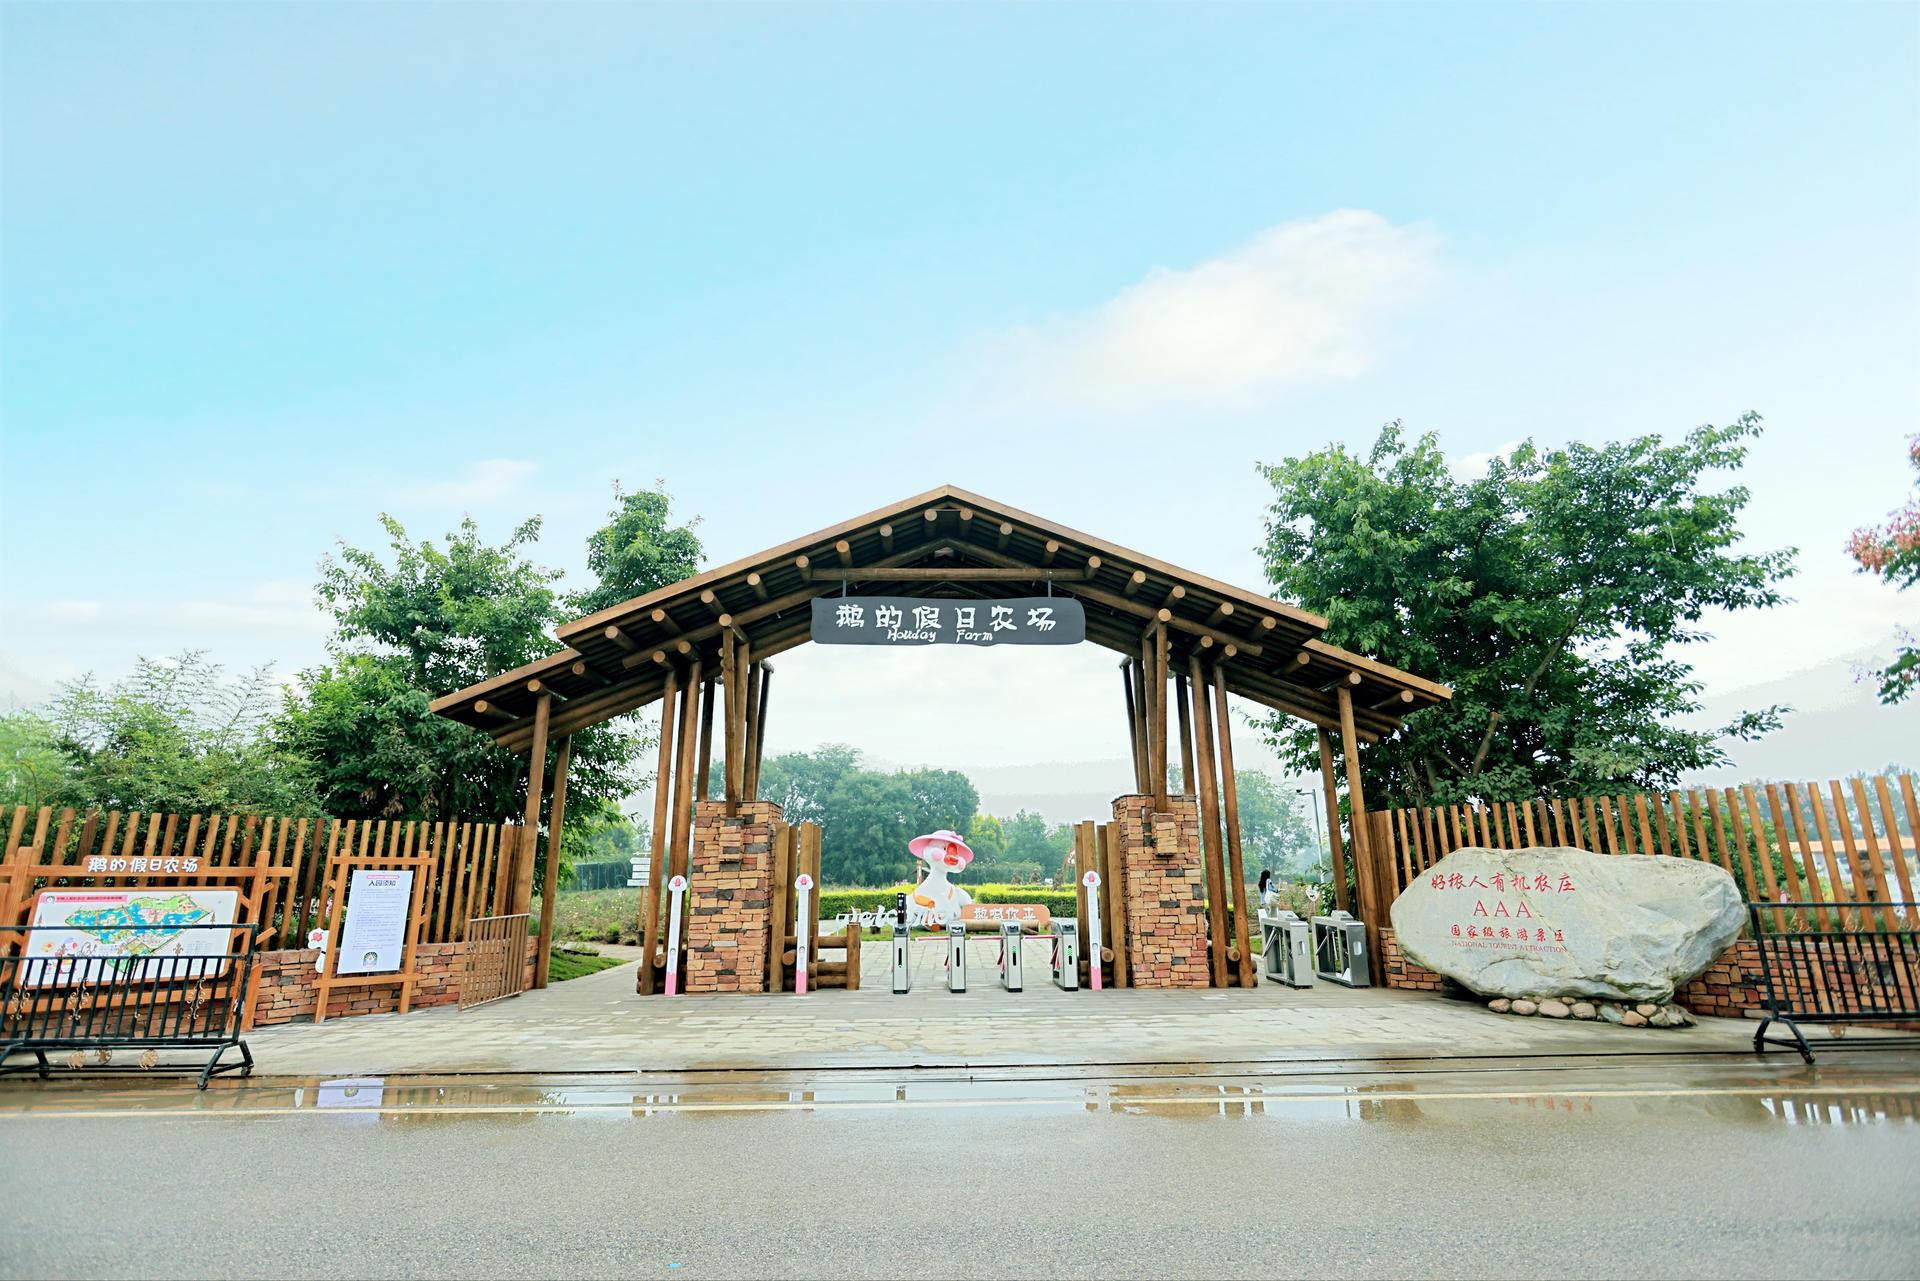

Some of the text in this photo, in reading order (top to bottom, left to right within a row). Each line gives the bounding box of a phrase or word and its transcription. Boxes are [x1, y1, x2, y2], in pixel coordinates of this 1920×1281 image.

[835, 604, 1057, 632] 鹅的假日农场
[887, 629, 994, 643] Holiday Farm
[87, 857, 199, 873] 鹅的假日农场
[1451, 924, 1566, 942] 国家级旅游景区
[1452, 940, 1569, 953] NATIONAL TOURIST ATTRACTION
